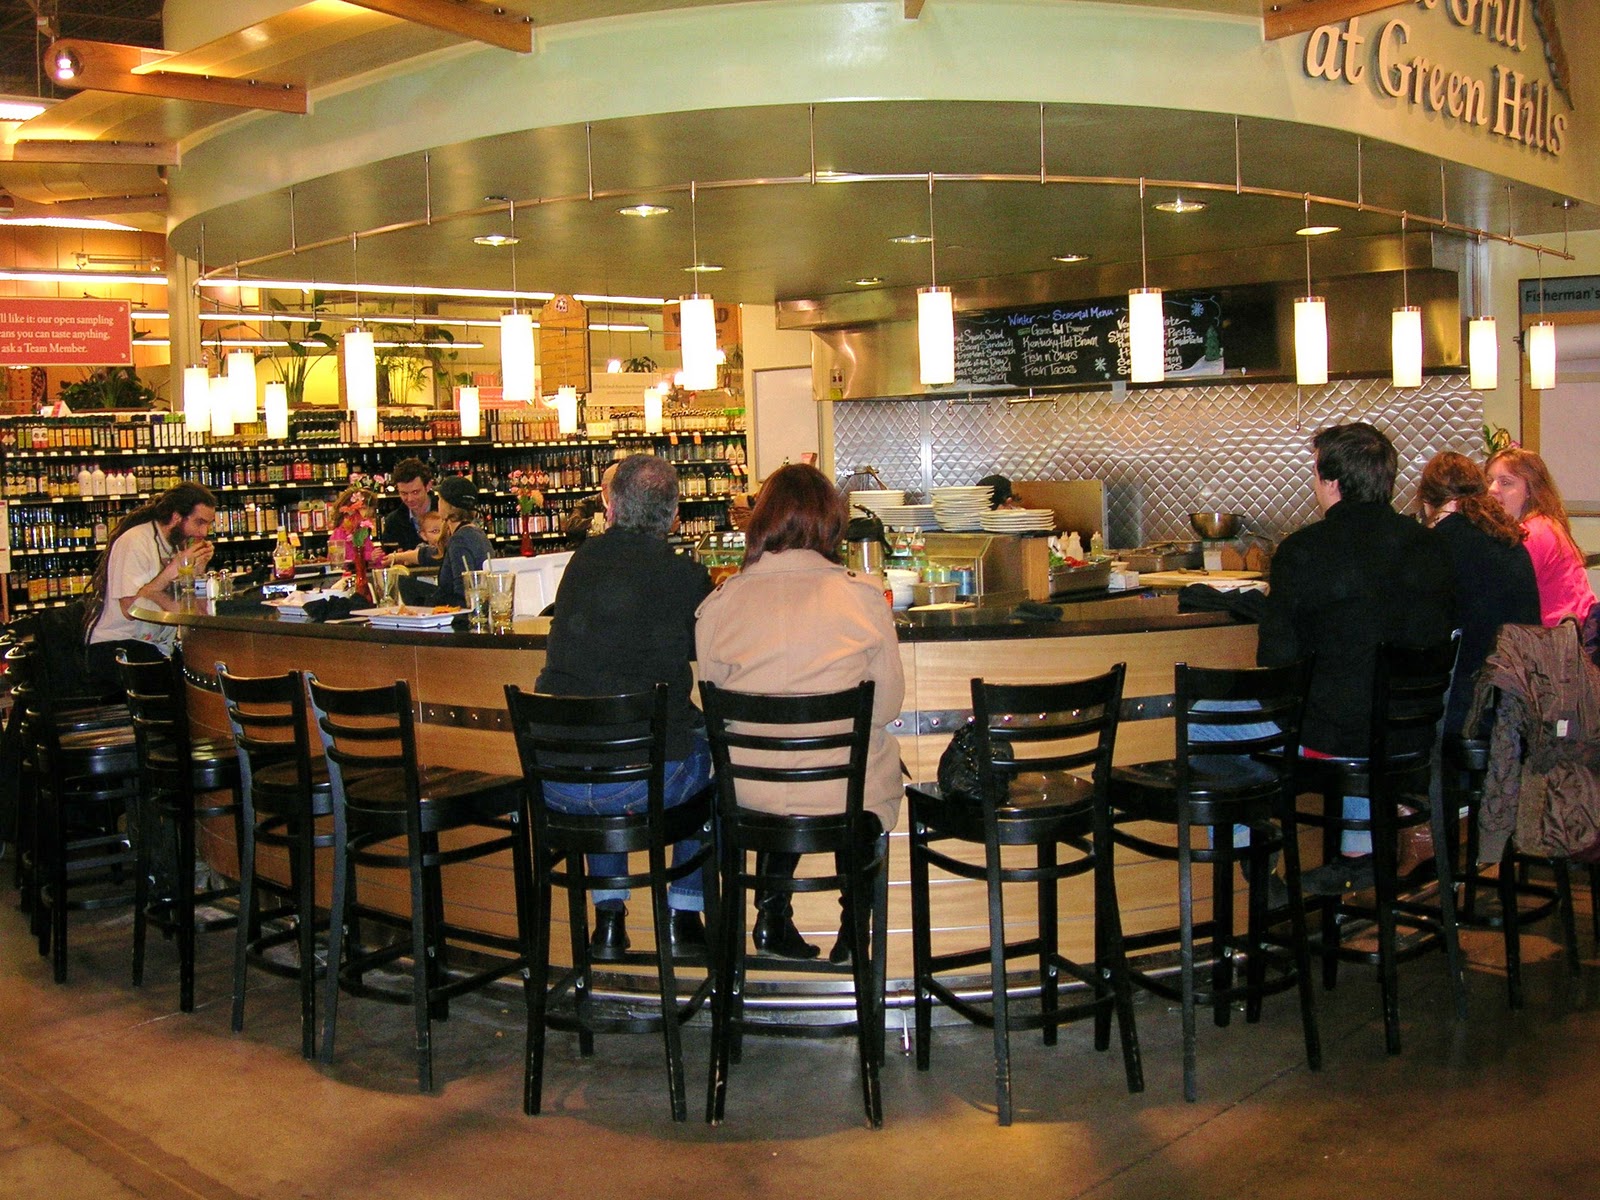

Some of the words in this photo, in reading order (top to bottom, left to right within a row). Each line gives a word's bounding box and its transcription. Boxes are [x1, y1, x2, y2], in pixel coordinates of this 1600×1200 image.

[1306, 16, 1365, 84] at
[1379, 19, 1488, 127] Green
[1493, 64, 1568, 156] Hills
[1525, 286, 1600, 302] Fisherman's
[9, 313, 25, 323] like
[27, 315, 35, 323] it:
[54, 317, 75, 327] open
[76, 314, 114, 327] sampling
[1008, 314, 1036, 326] Winter
[1052, 309, 1089, 321] Seasonal
[1090, 307, 1115, 319] Menu
[17, 330, 33, 340] you
[52, 330, 71, 339] taste
[72, 328, 110, 340] anything.
[1, 342, 16, 353] ask
[17, 345, 22, 353] a
[23, 342, 48, 353] Team
[49, 342, 88, 353] Member.
[1023, 336, 1060, 352] Kentucky
[1060, 334, 1074, 348] Hot
[1045, 362, 1077, 376] Tacos
